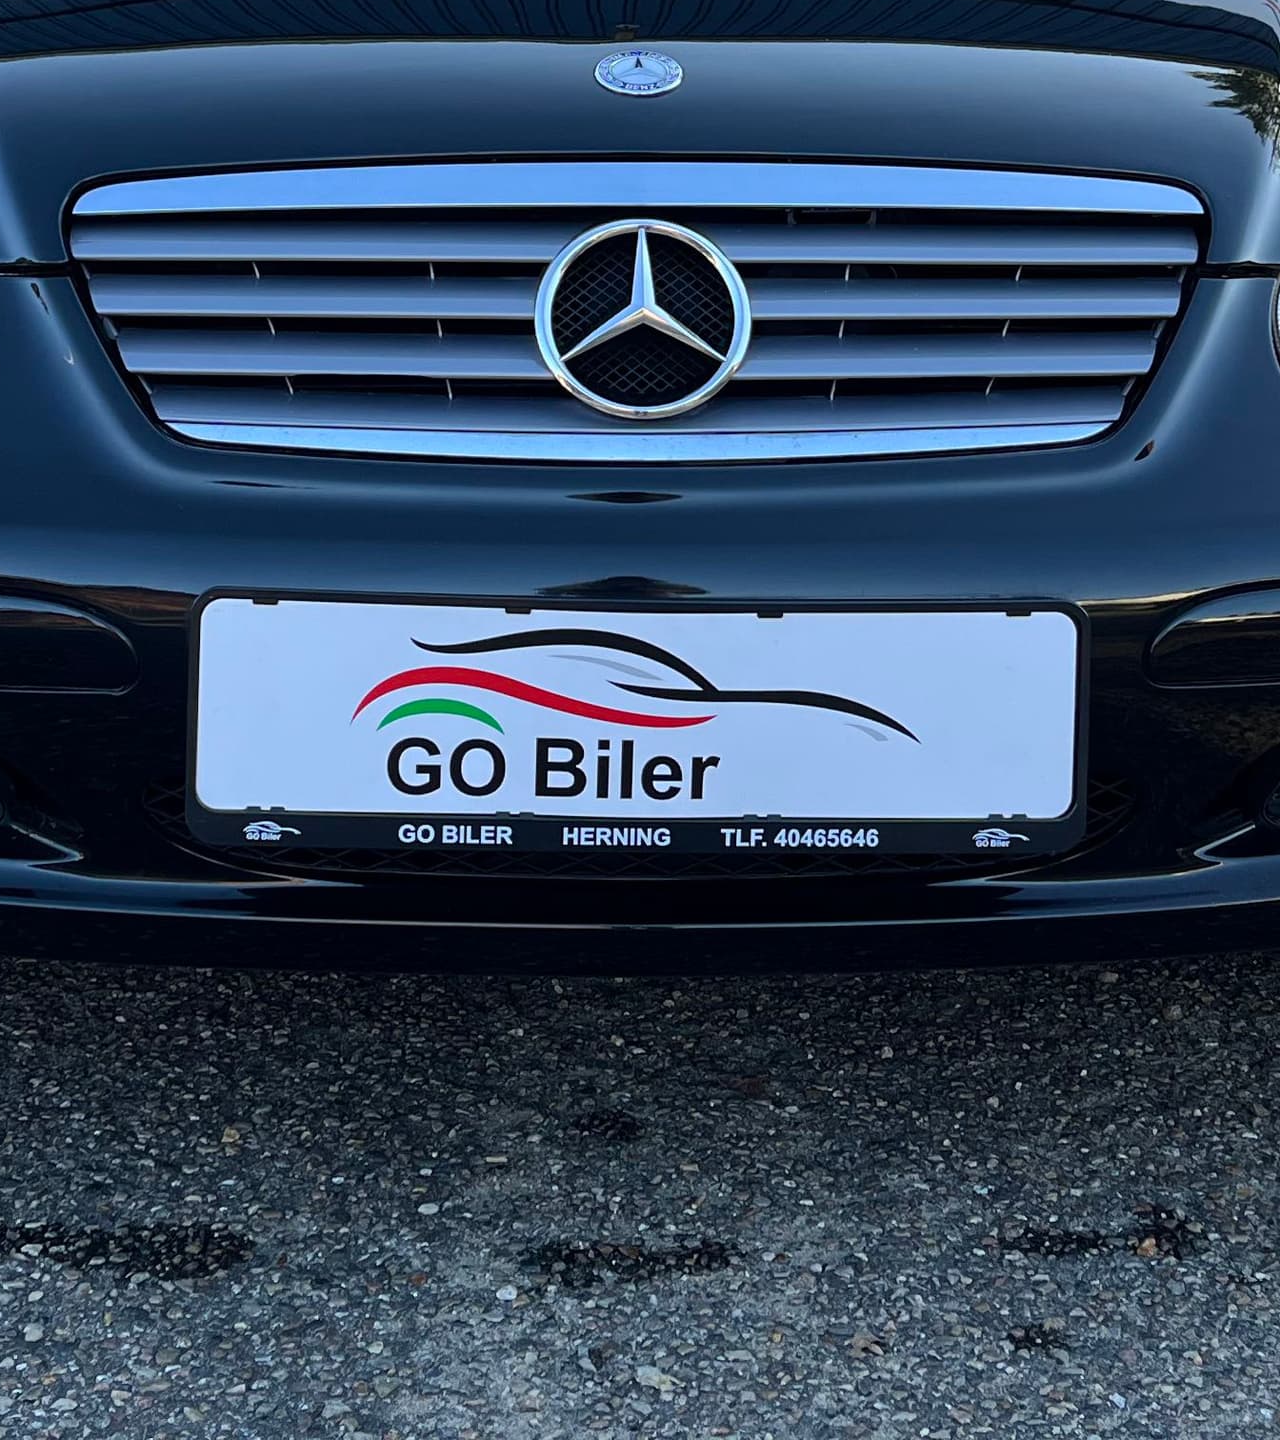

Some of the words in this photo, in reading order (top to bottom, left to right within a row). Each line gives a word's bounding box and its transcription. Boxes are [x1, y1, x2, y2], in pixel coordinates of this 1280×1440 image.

[387, 737, 507, 796] GO
[535, 737, 721, 800] Biler
[398, 824, 435, 844] GO
[442, 825, 513, 845] BILER
[562, 827, 671, 847] HERNING
[720, 827, 767, 847] TLF.
[773, 828, 880, 848] 40465646
